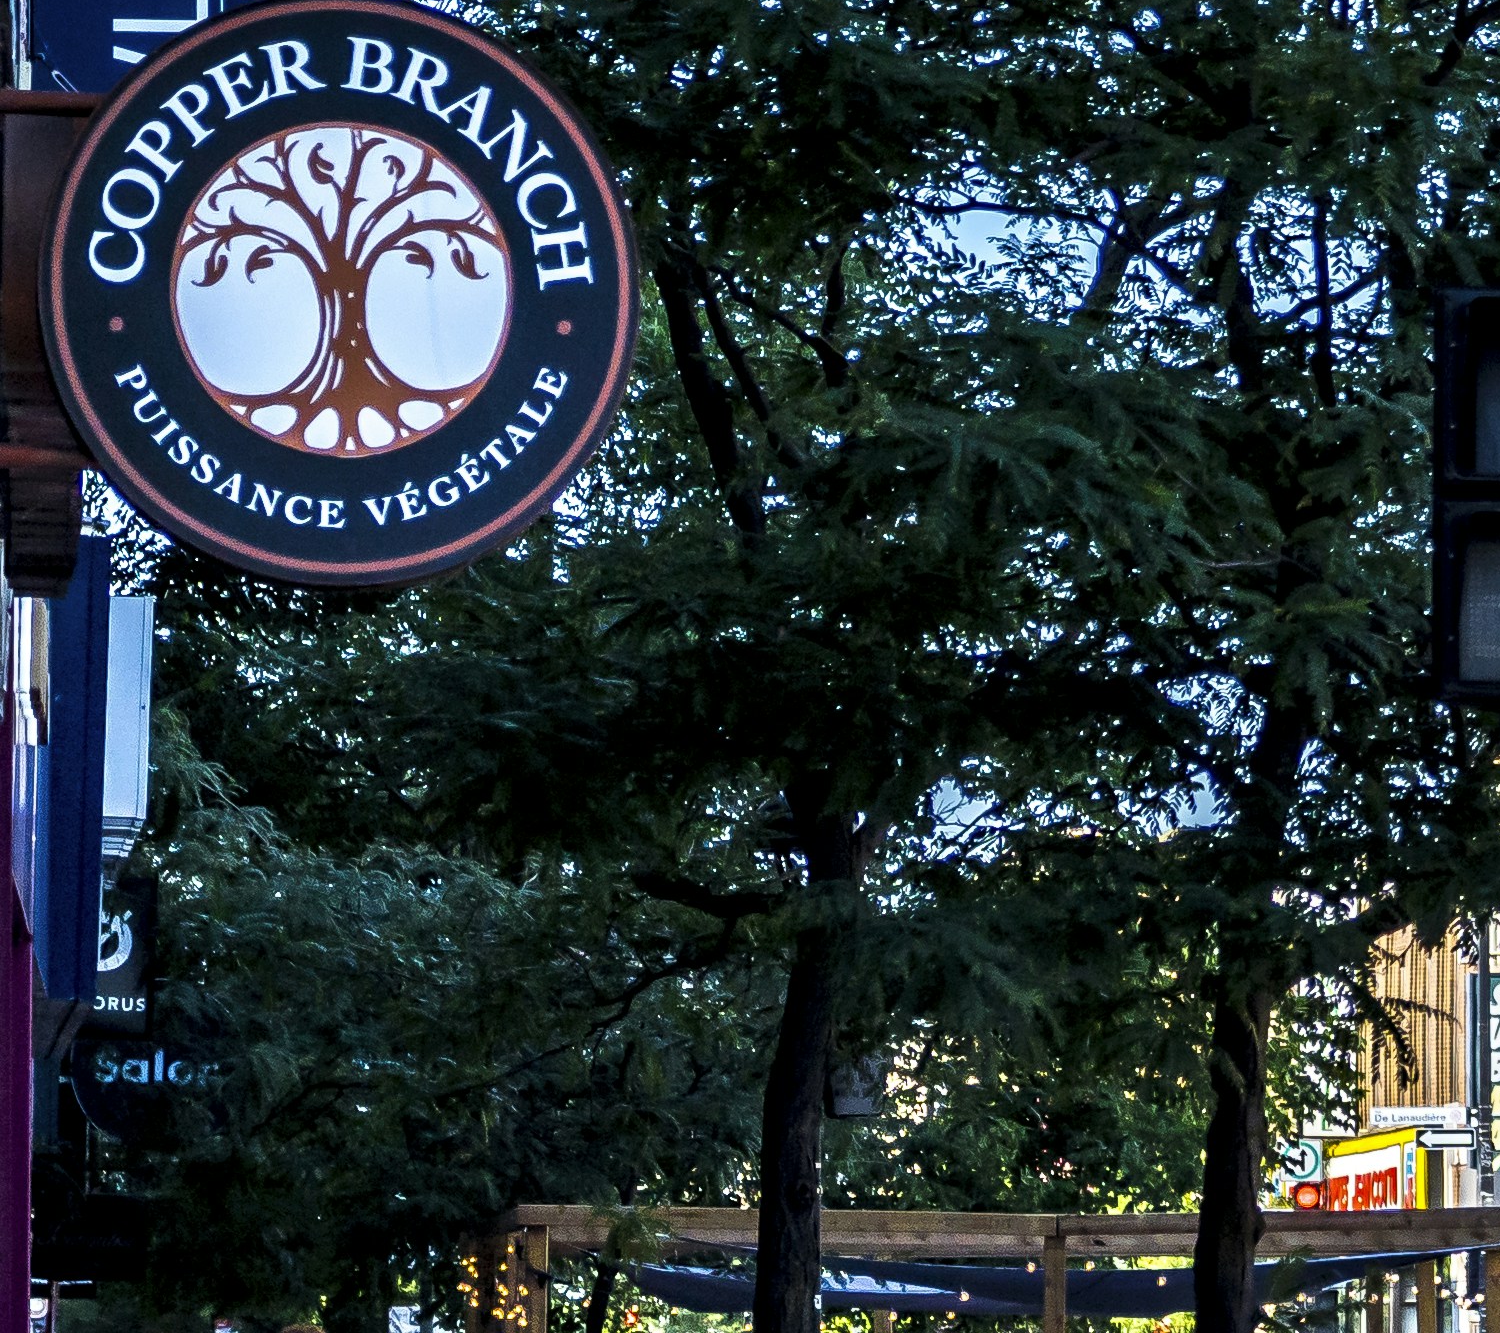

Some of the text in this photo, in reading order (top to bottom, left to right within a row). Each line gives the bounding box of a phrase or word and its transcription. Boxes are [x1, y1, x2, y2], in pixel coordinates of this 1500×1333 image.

[87, 35, 596, 292] COPPER BRANCH
[113, 362, 571, 530] PUISSANCE VÉGÉTALE
[1374, 1112, 1447, 1123] De Lanaudière
